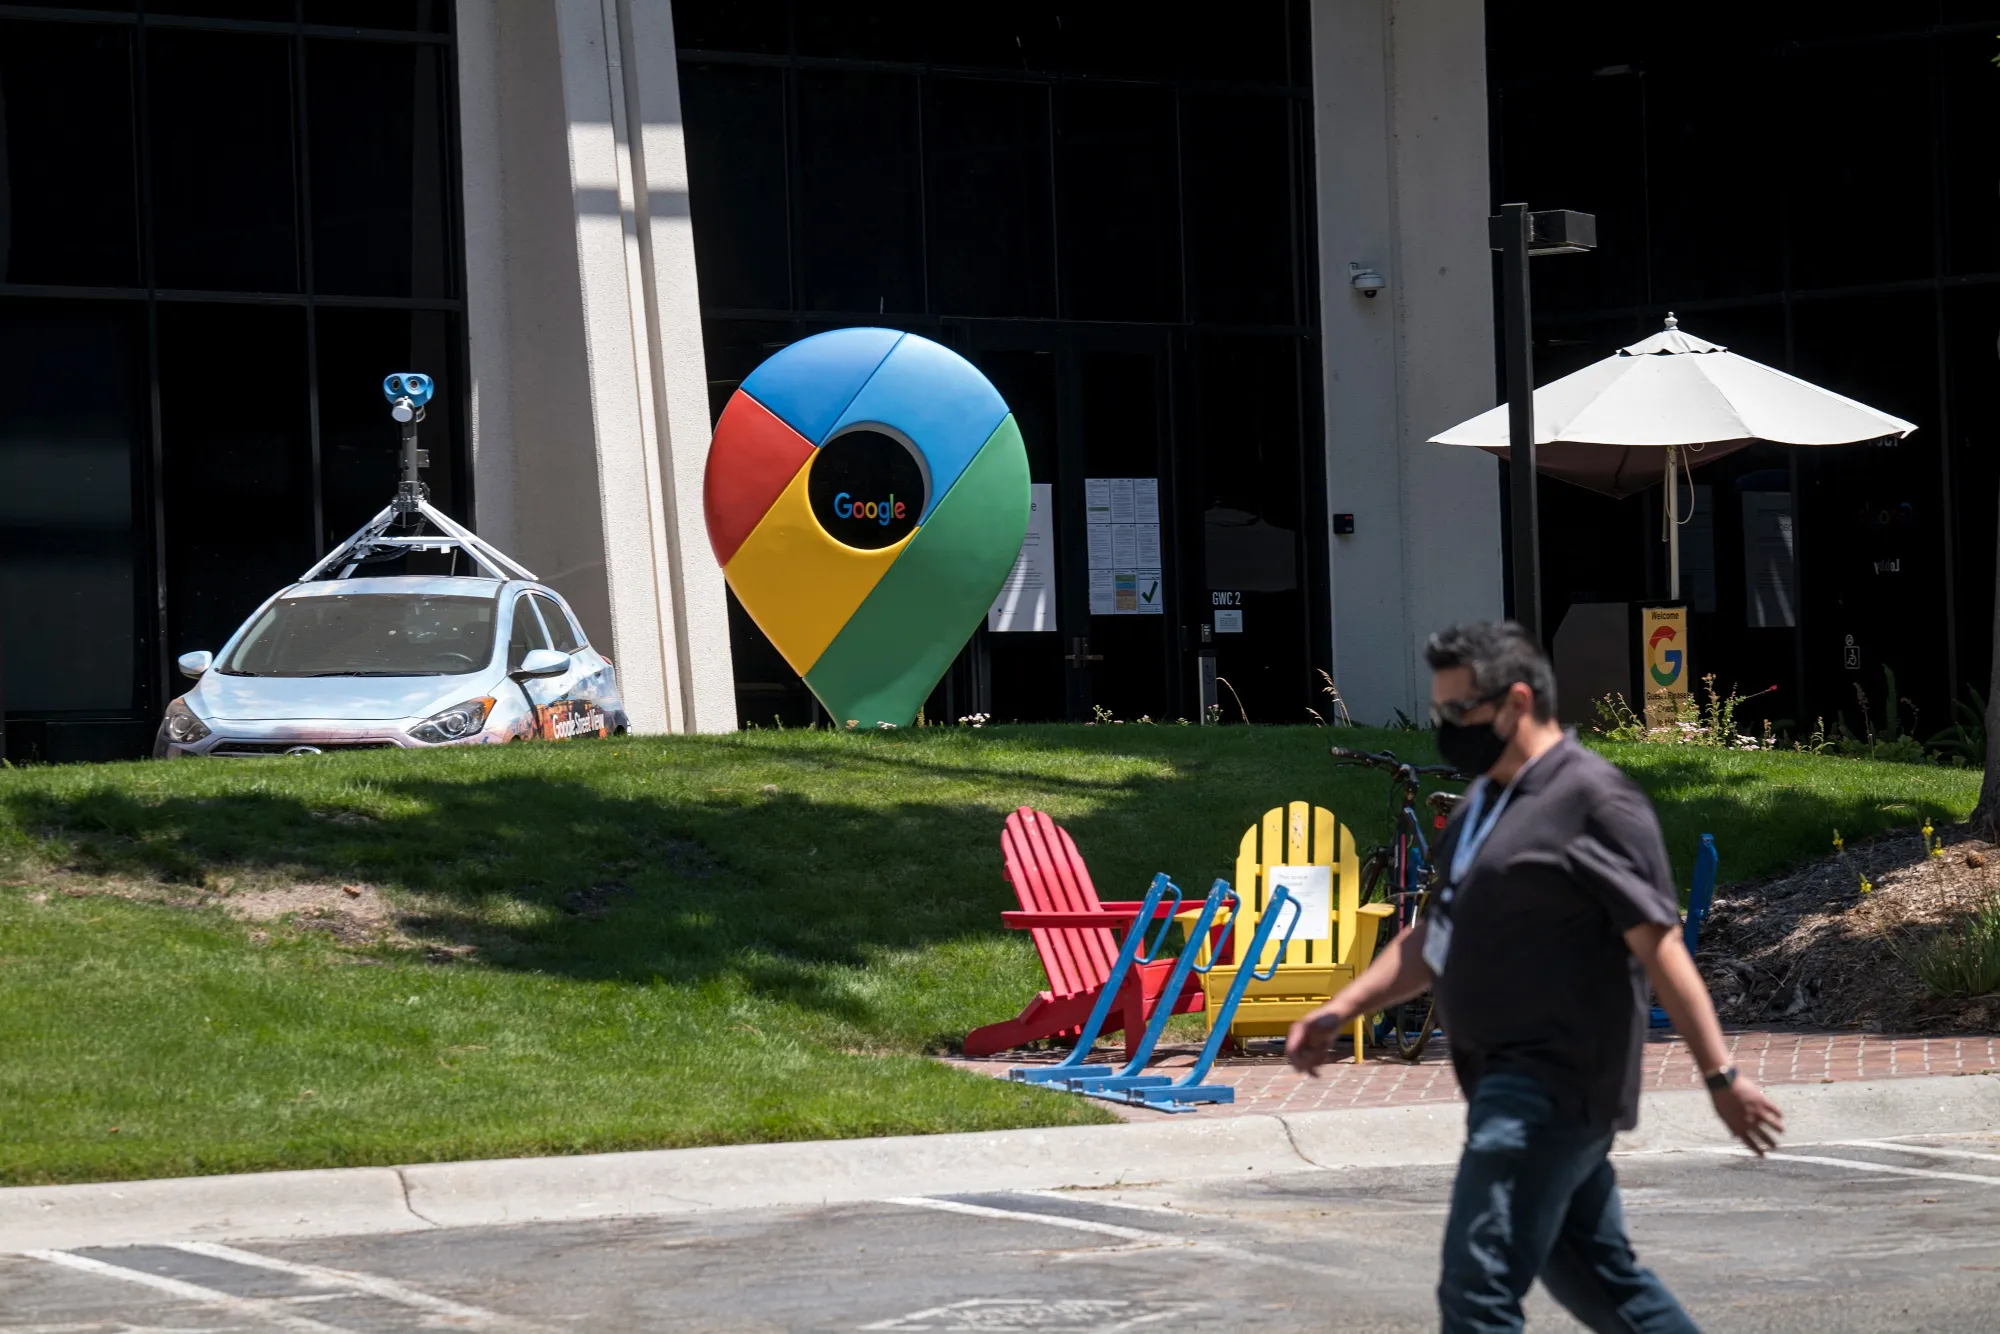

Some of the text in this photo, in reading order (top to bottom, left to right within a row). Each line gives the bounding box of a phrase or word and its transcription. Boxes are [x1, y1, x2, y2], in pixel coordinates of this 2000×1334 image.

[833, 492, 906, 526] Google
[1212, 591, 1241, 605] GWC 2
[1651, 611, 1679, 620] Welcome
[1648, 625, 1682, 687] G
[552, 711, 576, 739] Google
